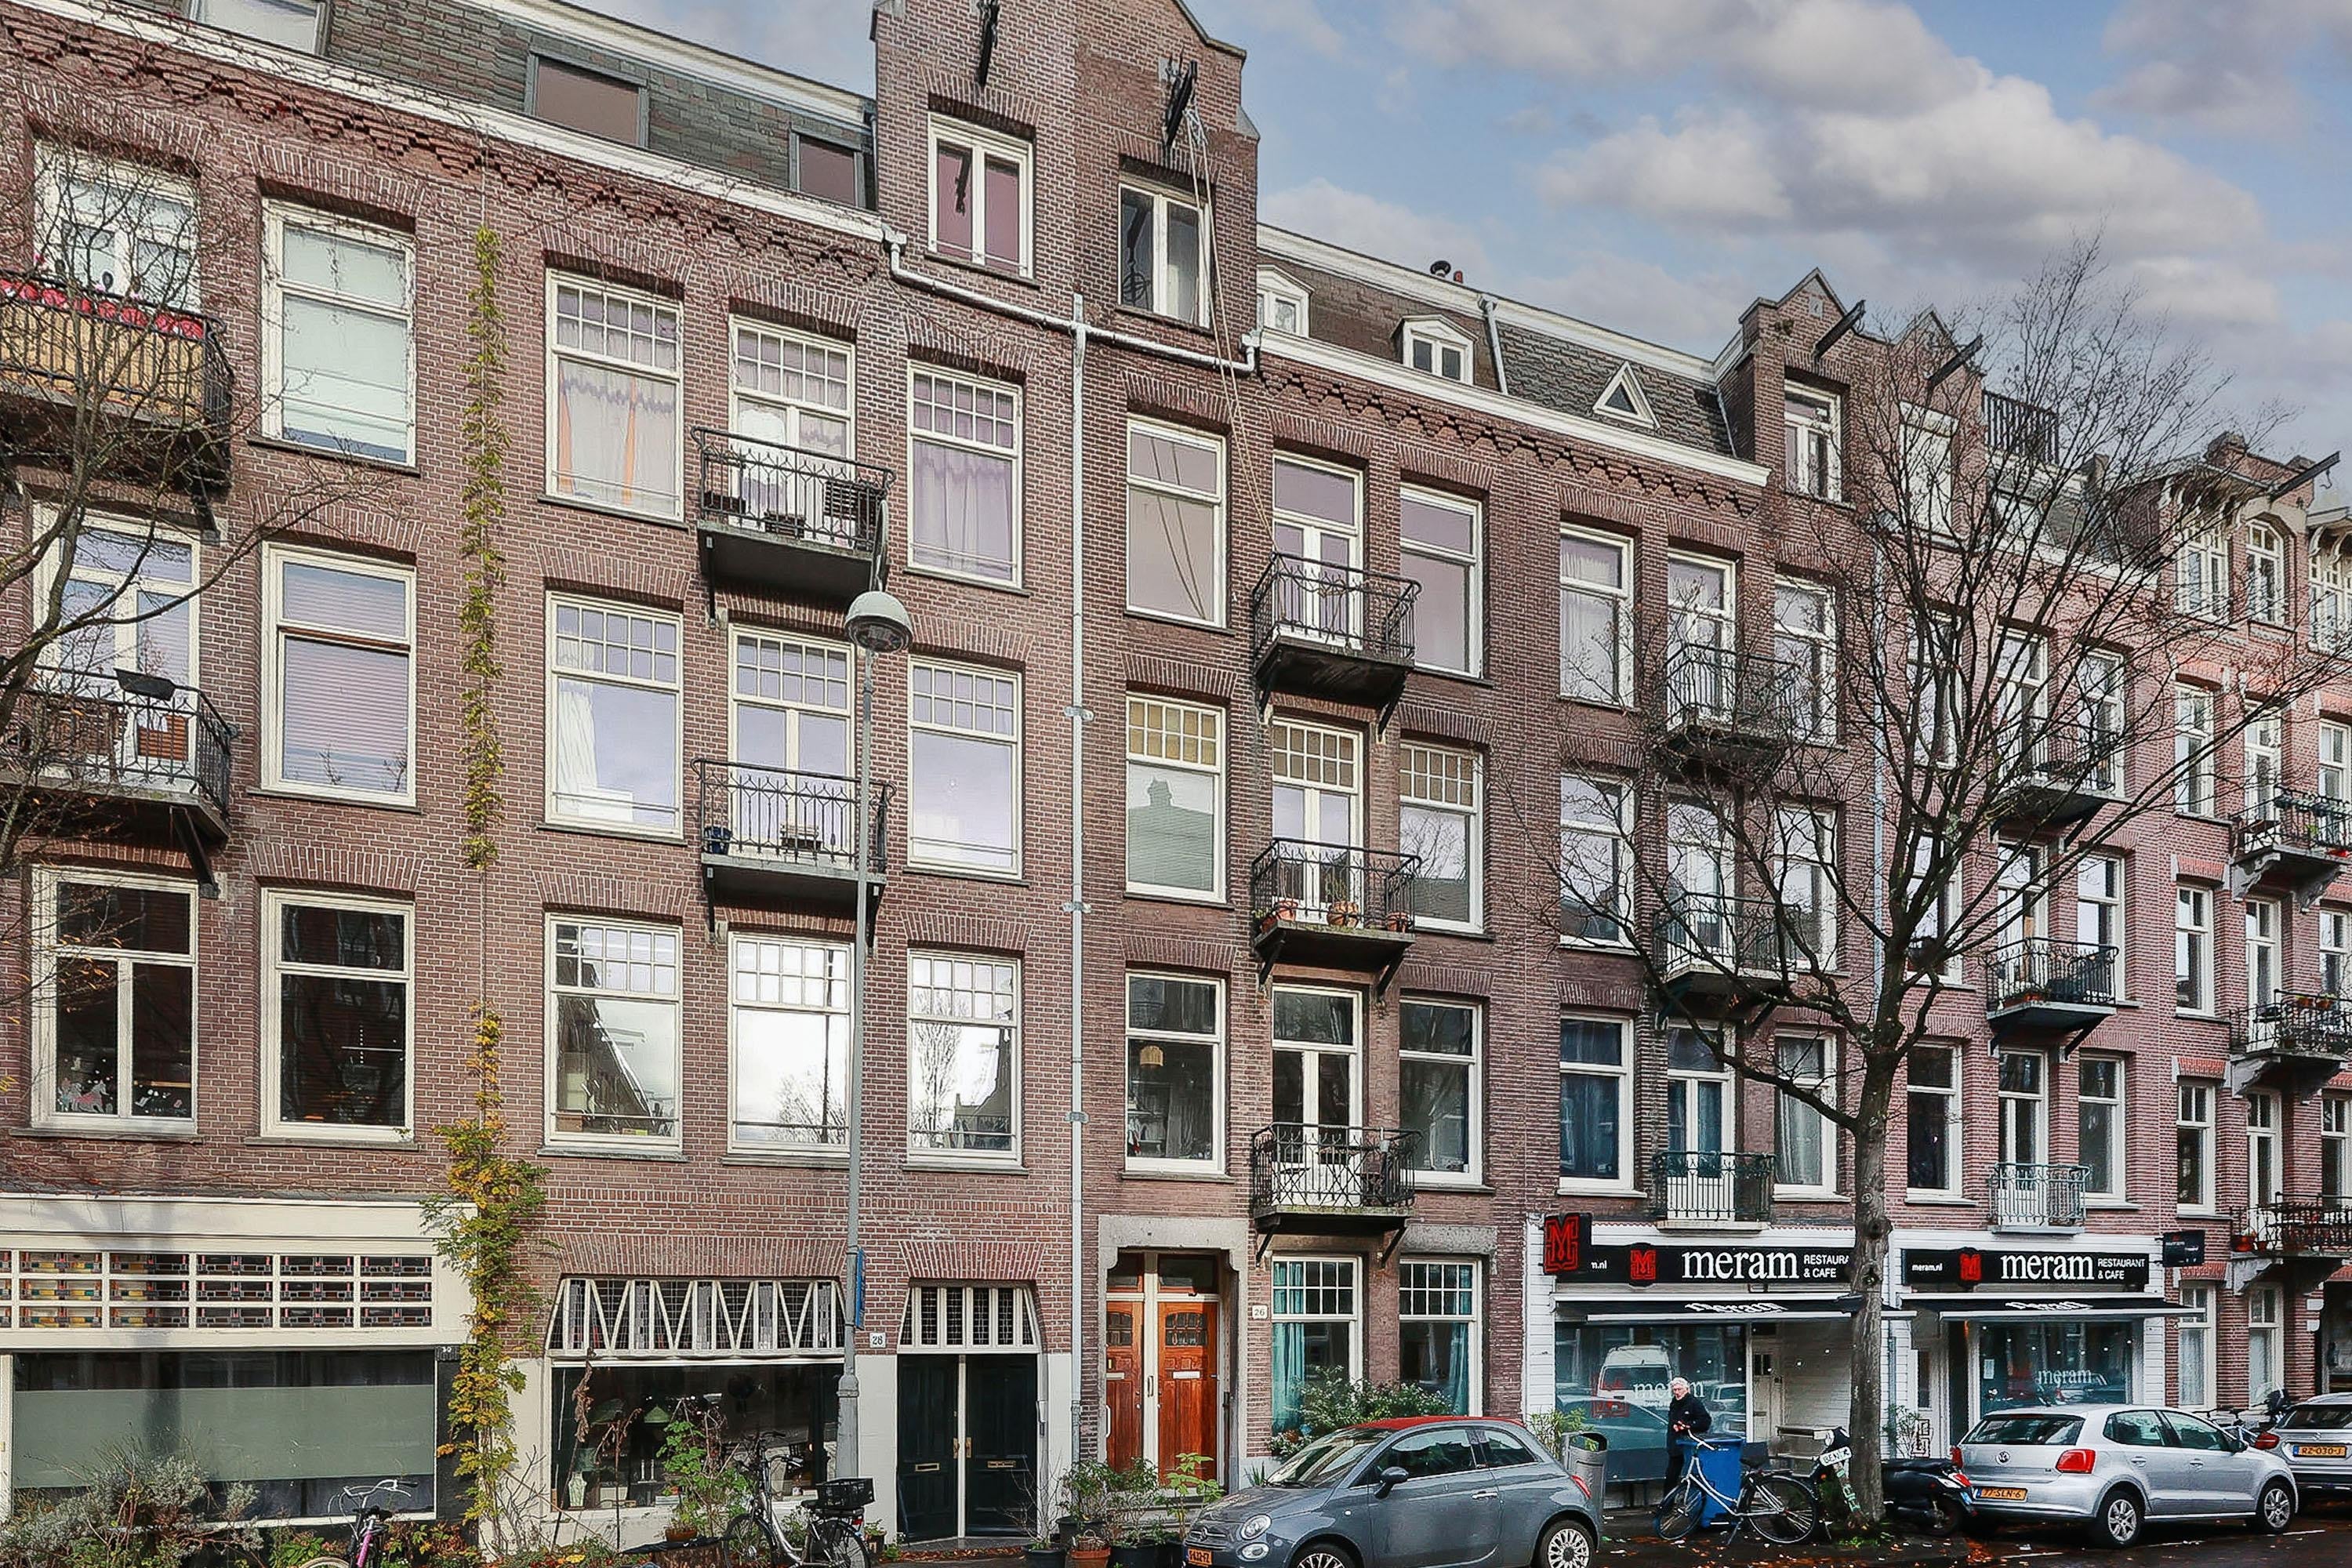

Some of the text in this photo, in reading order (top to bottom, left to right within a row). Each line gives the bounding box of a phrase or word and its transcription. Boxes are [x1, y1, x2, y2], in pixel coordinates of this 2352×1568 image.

[1682, 1251, 1799, 1279] meram
[2000, 1254, 2094, 1280] meram
[2097, 1258, 2145, 1268] RESTAURANT
[1803, 1268, 1837, 1278] & CAFE
[2097, 1270, 2125, 1279] & CAFE
[2038, 1368, 2092, 1385] meram
